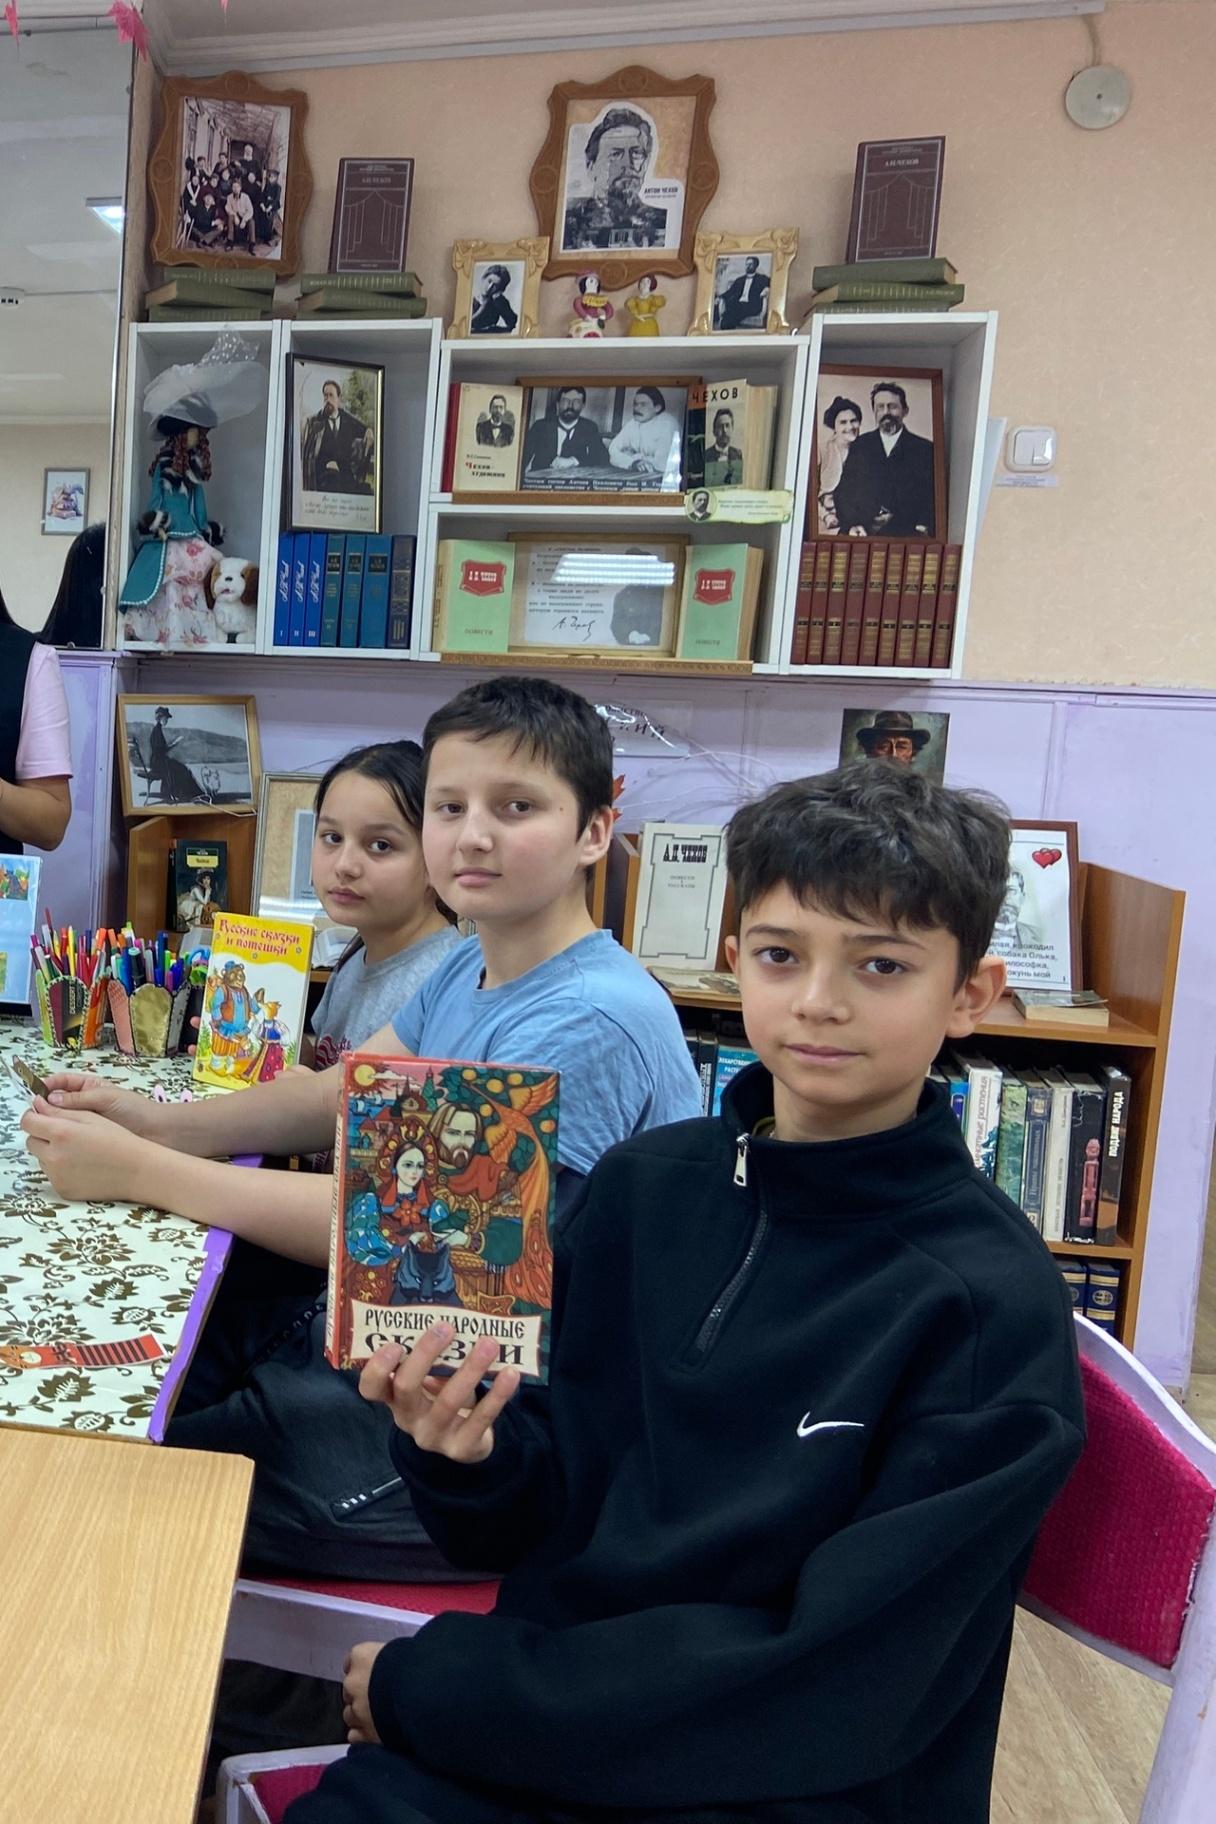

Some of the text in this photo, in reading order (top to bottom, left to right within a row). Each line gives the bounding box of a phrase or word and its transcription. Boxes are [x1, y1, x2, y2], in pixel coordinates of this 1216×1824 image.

[691, 387, 739, 404] ЧЕХОВ
[681, 844, 708, 863] ЧЕХОВ
[219, 919, 300, 945] Русские сказки
[226, 936, 287, 956] и потешки
[1108, 1091, 1125, 1157] ПОДВИГ НАРОДА
[364, 1308, 435, 1334] РУССКИЕ
